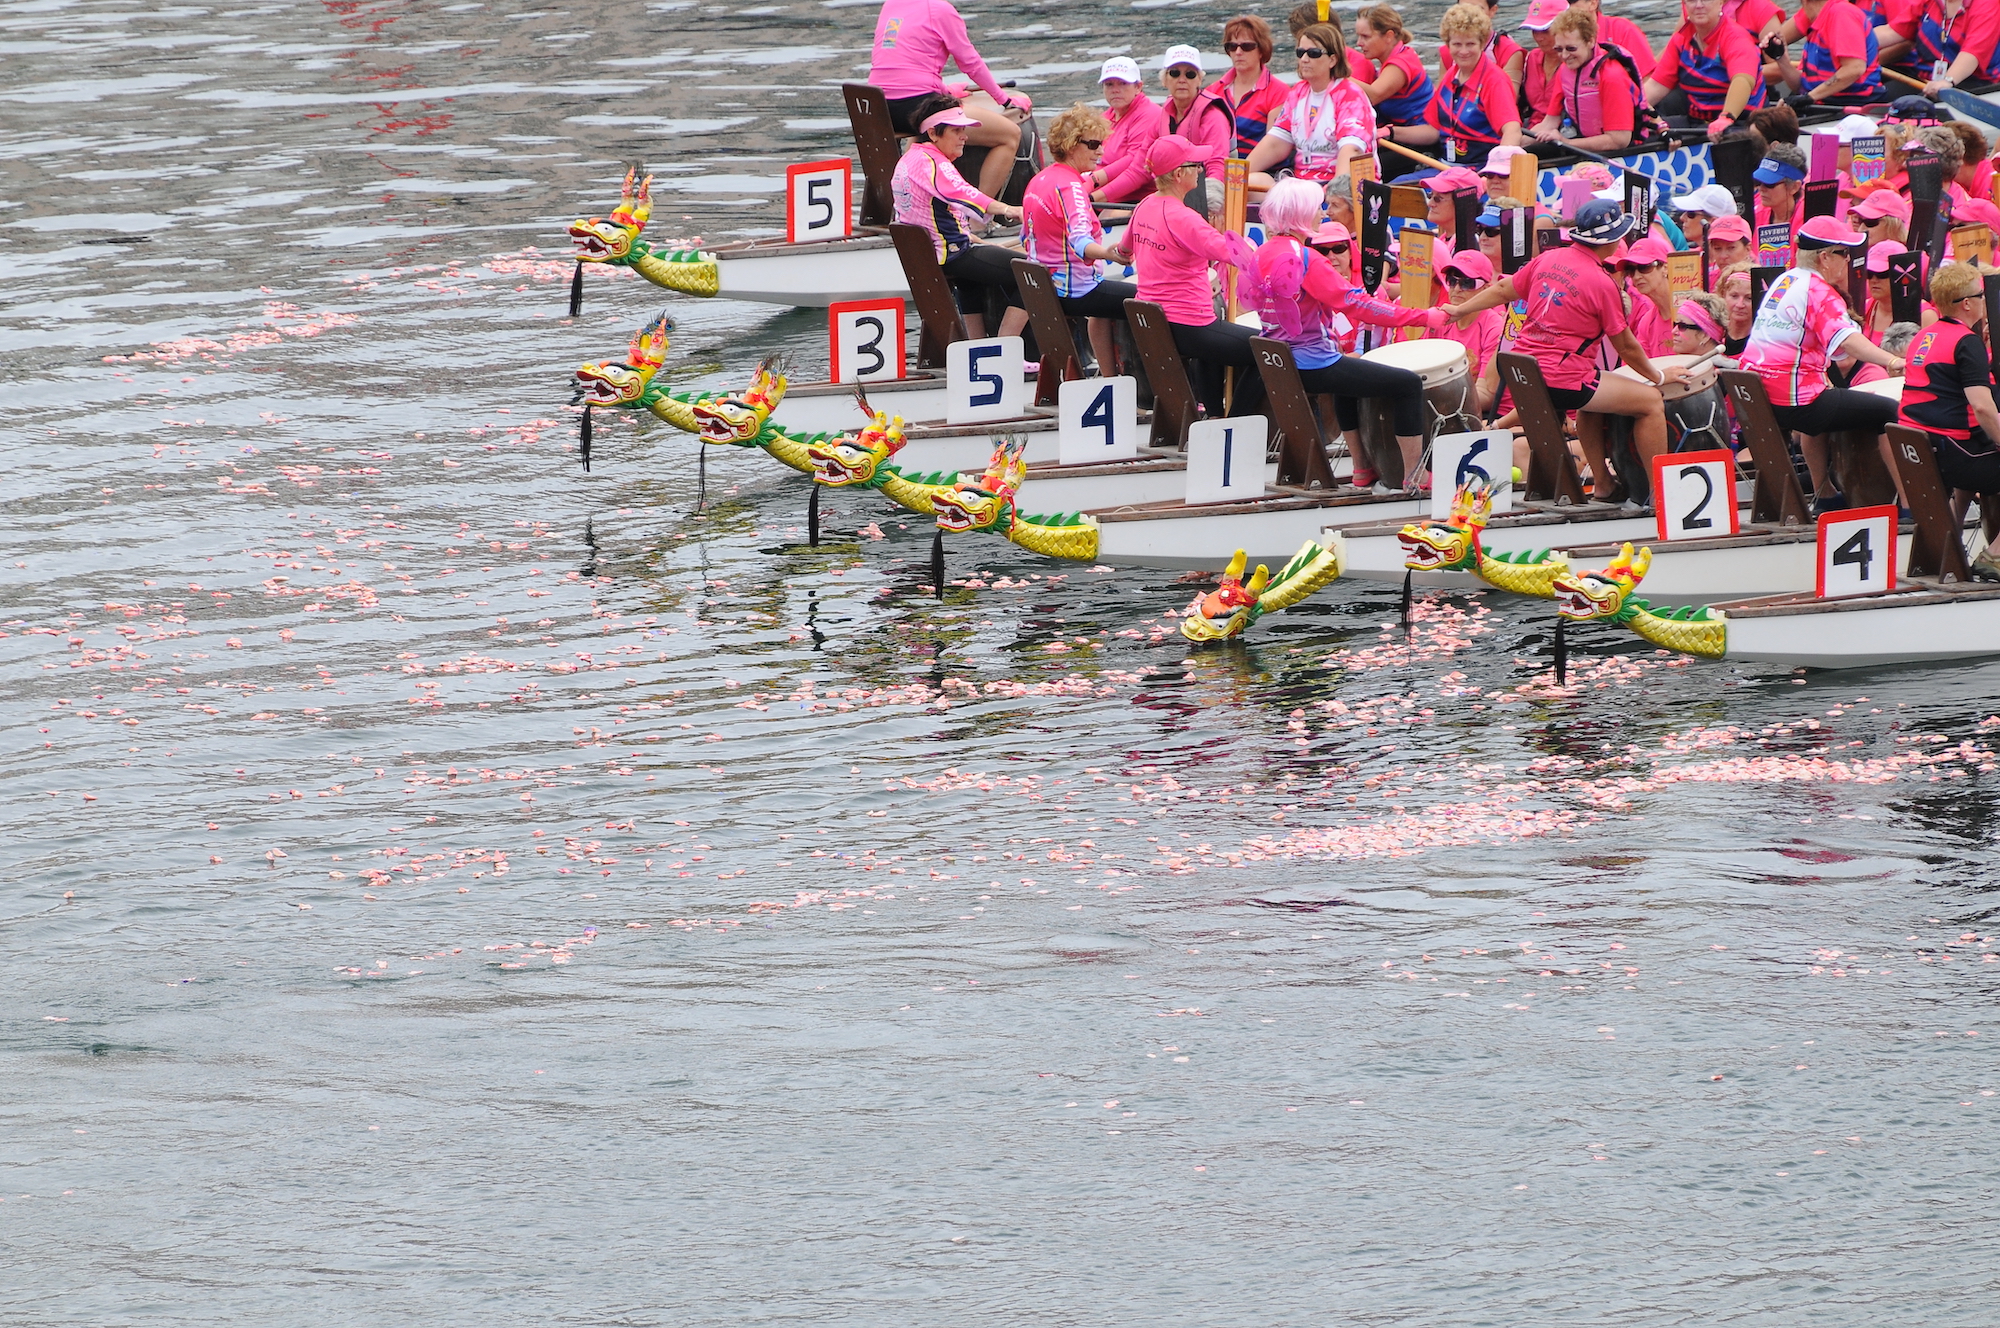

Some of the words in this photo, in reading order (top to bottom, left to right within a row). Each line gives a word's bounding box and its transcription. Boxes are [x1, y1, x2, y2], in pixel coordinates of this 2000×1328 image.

[1853, 139, 1884, 147] ABREAST
[1853, 146, 1884, 154] DRAGONS
[808, 178, 833, 230] 5
[1759, 226, 1790, 236] ABREAST
[1759, 234, 1790, 244] DRAGONS
[1537, 271, 1580, 298] DRAGONFLIES
[1551, 263, 1579, 280] AUSSIE
[855, 316, 885, 376] 3
[969, 345, 1003, 407] 5
[1081, 385, 1114, 445] 4
[1221, 428, 1233, 488] 1
[1455, 438, 1490, 495] 6
[1680, 465, 1713, 530] 2
[1833, 528, 1873, 581] 4
